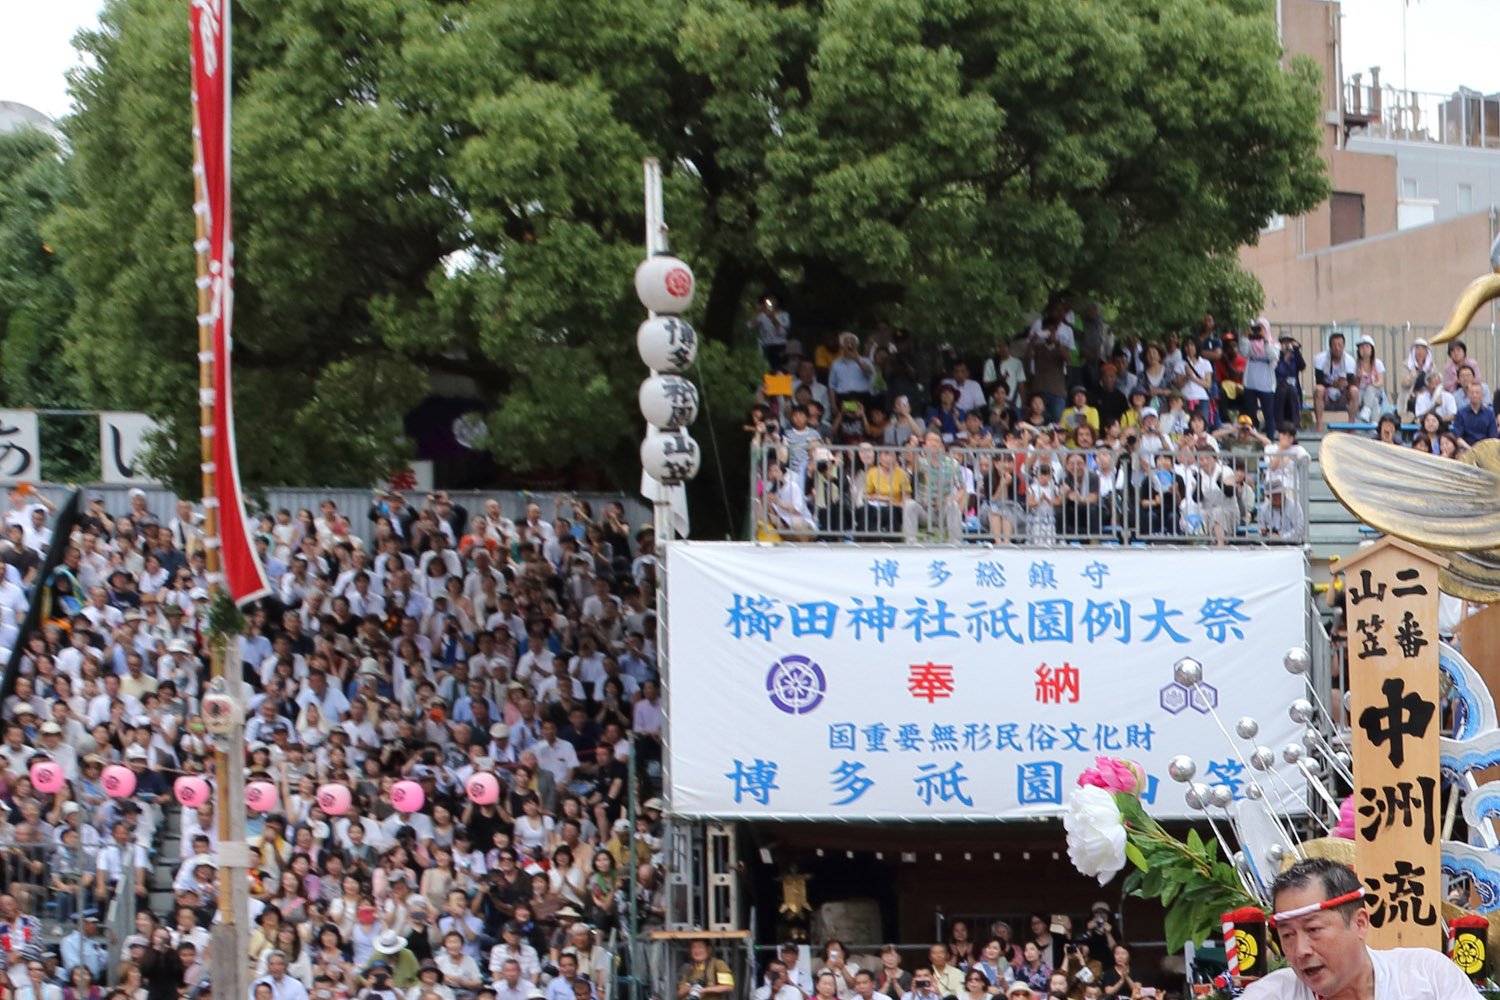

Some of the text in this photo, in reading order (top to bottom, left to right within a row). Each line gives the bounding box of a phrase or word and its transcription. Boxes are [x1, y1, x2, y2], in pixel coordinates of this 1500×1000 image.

[869, 558, 1110, 590] 博多総鎮守
[724, 594, 1252, 643] 櫛田神社祇園例大祭
[1349, 569, 1388, 660] 山笠
[1391, 568, 1428, 659] 二番
[907, 662, 1080, 704] 奉納
[827, 721, 1156, 753] 国重要無形民俗文化財
[724, 757, 1249, 806] 博多祇園笠
[1358, 677, 1438, 930] 中洲流
